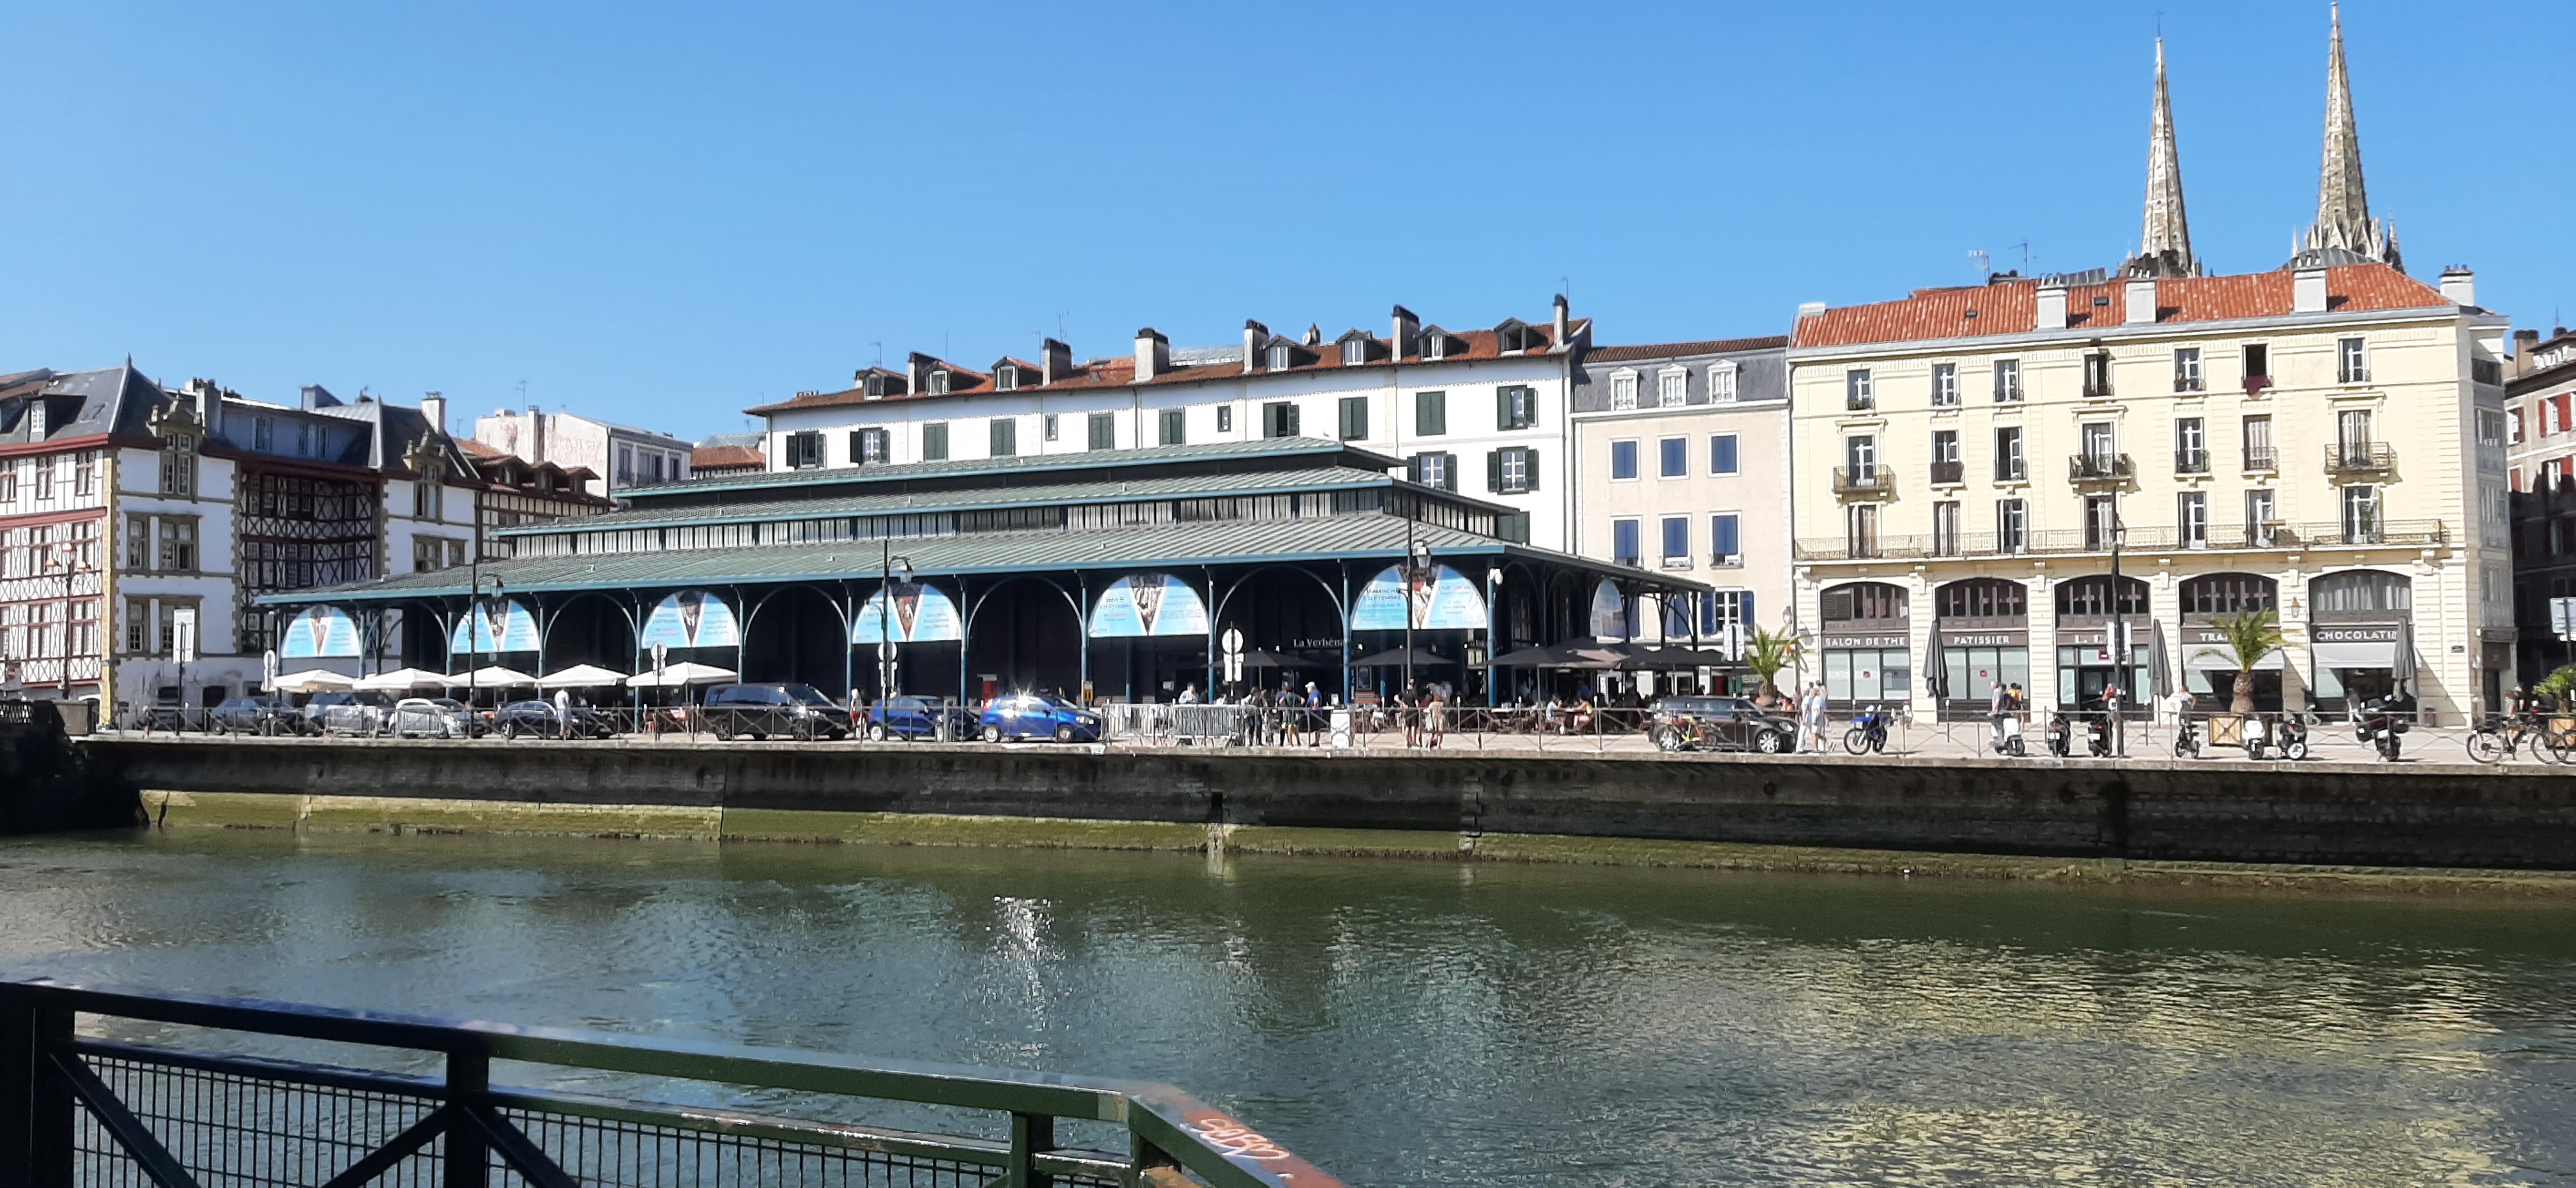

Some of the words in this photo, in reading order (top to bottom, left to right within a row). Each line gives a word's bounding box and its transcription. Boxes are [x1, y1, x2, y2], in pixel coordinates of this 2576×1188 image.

[2316, 630, 2397, 640] CHOCOLATIE
[1293, 639, 1305, 647] La
[1825, 637, 1861, 646] SALON
[1866, 637, 1879, 646] DE
